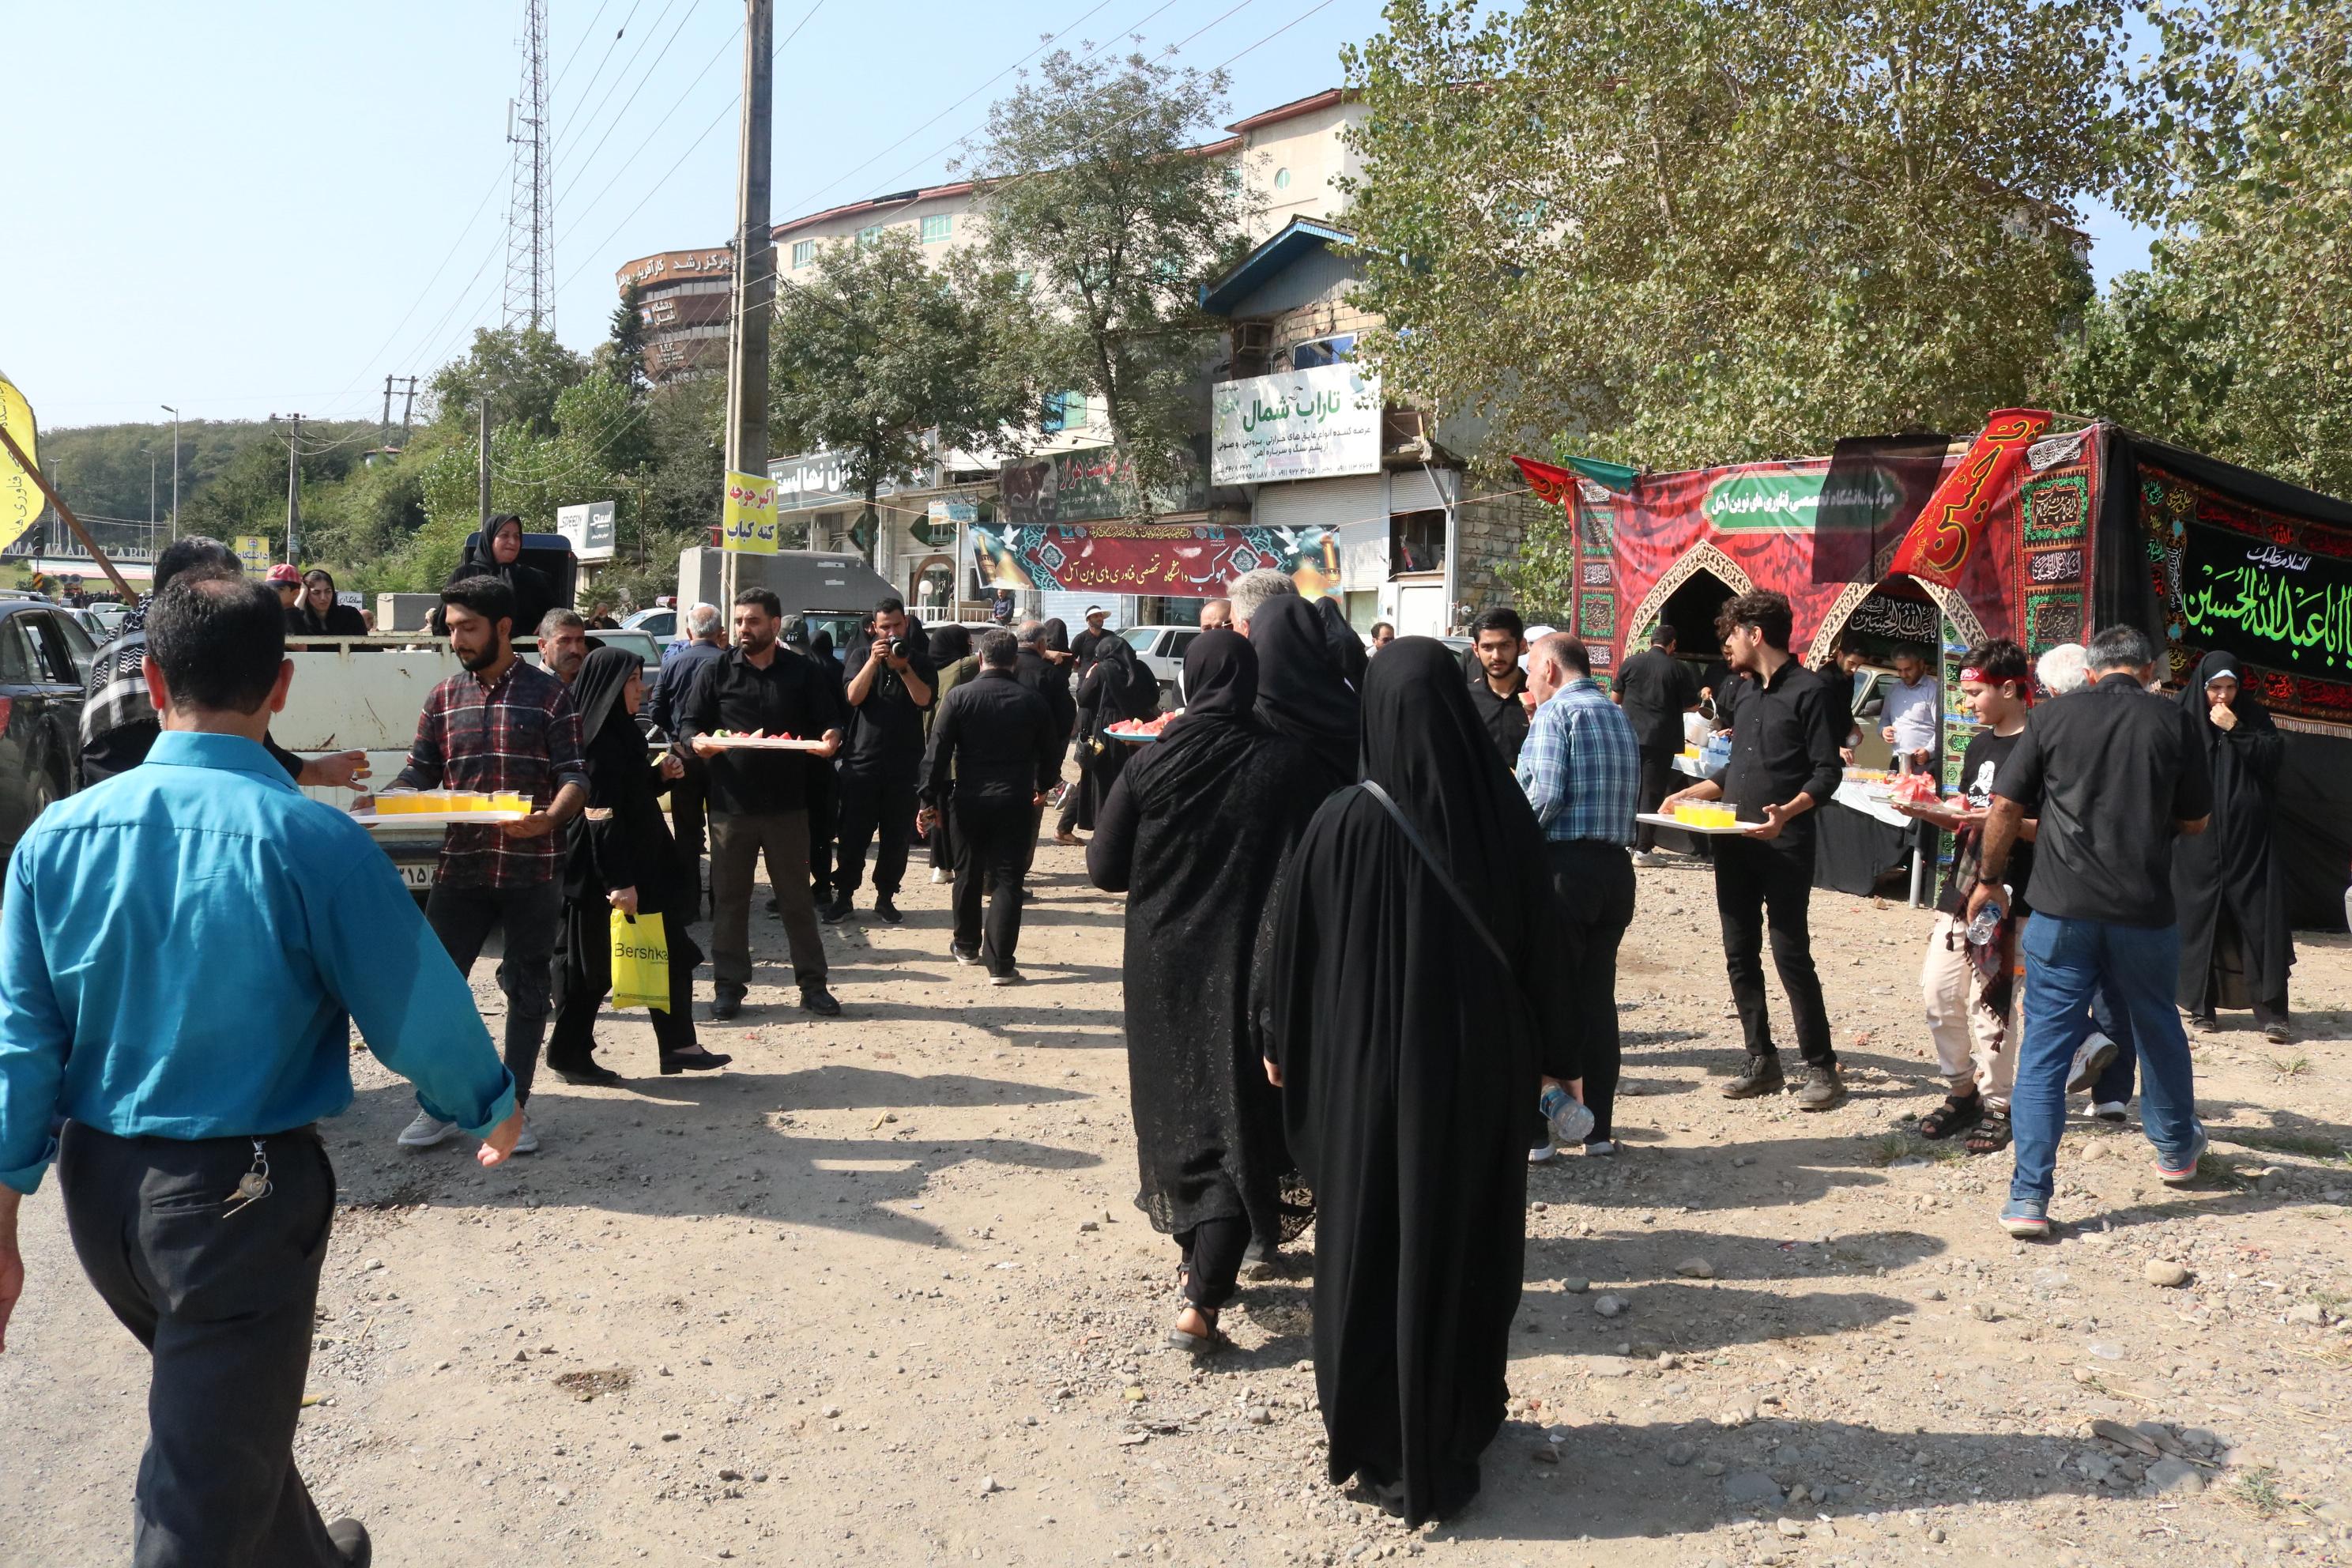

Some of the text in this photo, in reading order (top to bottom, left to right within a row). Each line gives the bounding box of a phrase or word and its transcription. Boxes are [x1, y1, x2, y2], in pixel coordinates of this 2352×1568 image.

[673, 254, 701, 271] رشد
[651, 302, 673, 312] دانشگاه
[654, 311, 676, 325] شمال
[1243, 390, 1340, 432] تاراب شمال
[1287, 432, 1300, 442] های
[1302, 432, 1317, 442] عایق
[1317, 430, 1332, 440] انواع
[1332, 428, 1352, 437] کننده
[1352, 427, 1371, 435] عرضه
[1217, 441, 1234, 452] صوتی
[1292, 444, 1307, 453] سنگ
[1308, 444, 1324, 453] پشم
[771, 462, 824, 495] نهالستا
[729, 485, 775, 510] اکبر جوجه
[1060, 496, 1070, 504] است
[1711, 492, 1729, 515] آمل
[1728, 492, 1751, 514] نوین
[1749, 492, 1764, 513] های
[1763, 489, 1789, 513] فناوری
[727, 521, 775, 543] کته کباب
[236, 550, 269, 560] دانشگاه
[2246, 545, 2286, 570] علیک
[1064, 560, 1080, 582] آمل
[1080, 562, 1095, 586] نوین
[1096, 565, 1109, 583] های
[1110, 564, 1136, 583] فناوری
[1136, 553, 1161, 585] تخصصی
[1164, 560, 1189, 582] دانشگاه
[1189, 546, 1230, 592] موکب
[614, 942, 669, 961] Bershka
